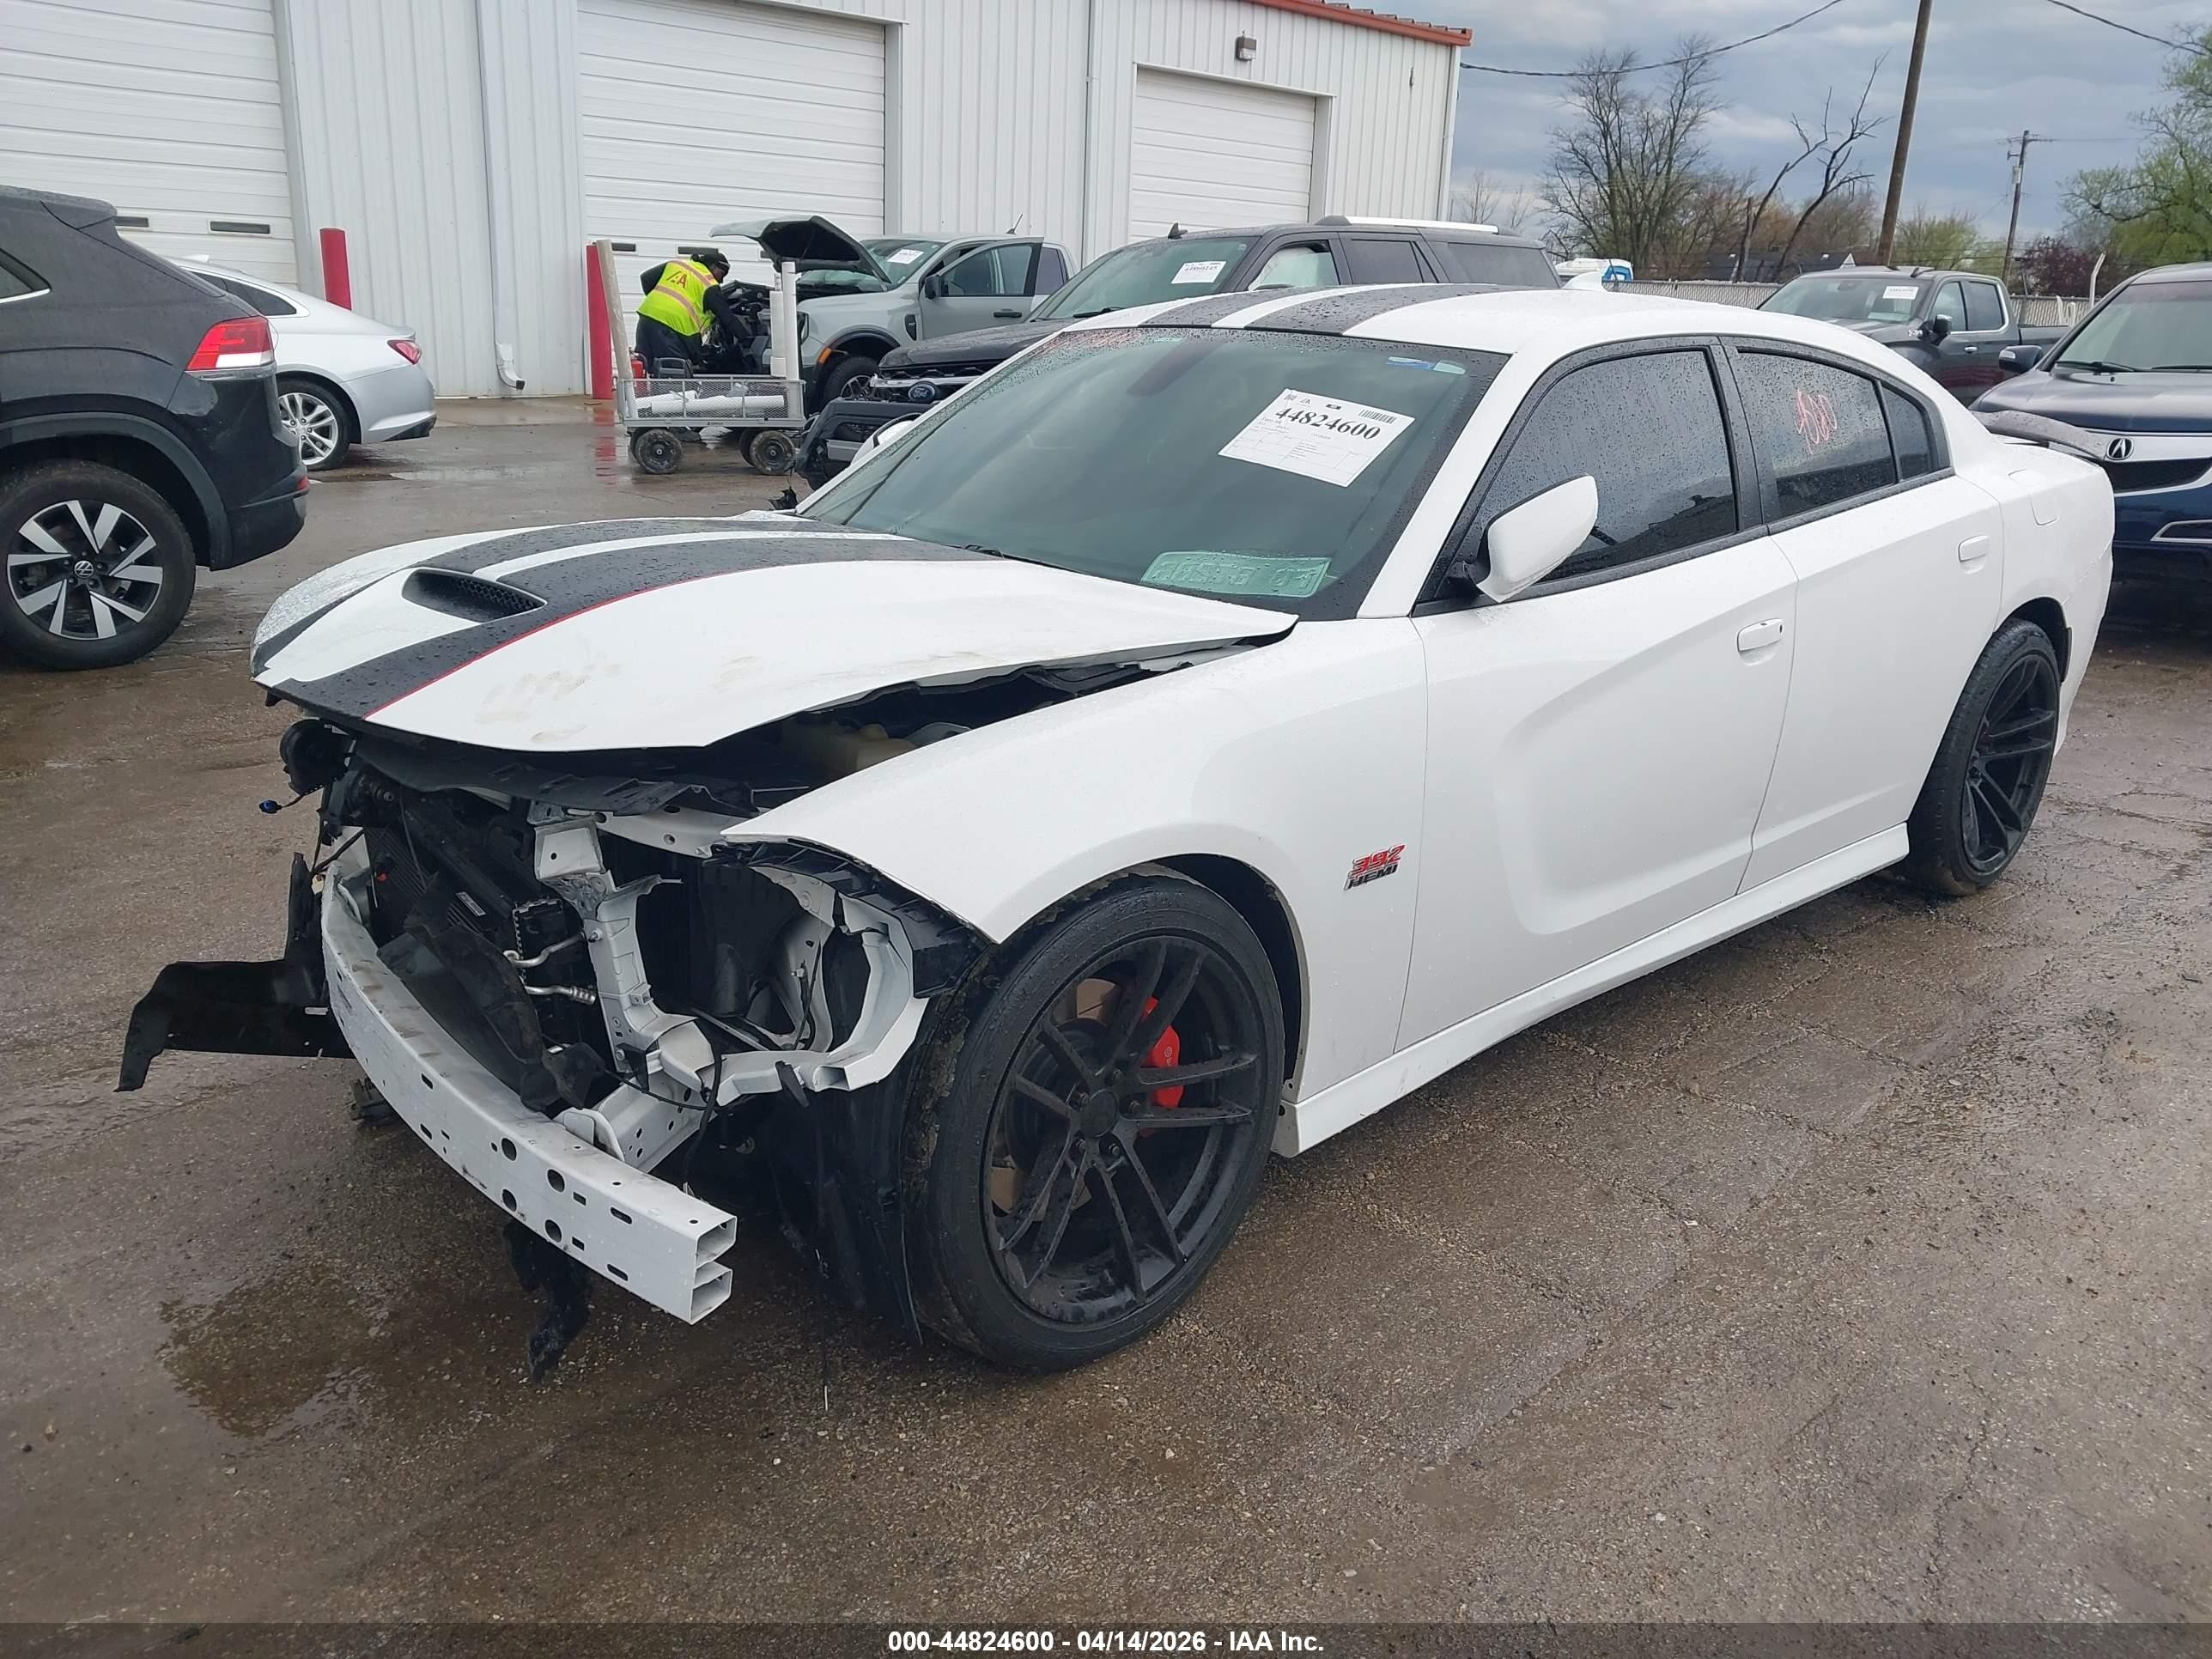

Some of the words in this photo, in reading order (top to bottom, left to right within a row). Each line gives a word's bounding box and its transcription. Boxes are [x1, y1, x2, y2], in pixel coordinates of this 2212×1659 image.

[1275, 408, 1381, 439] 44824600
[1344, 862, 1399, 890] HEMI
[1347, 844, 1405, 877] 392
